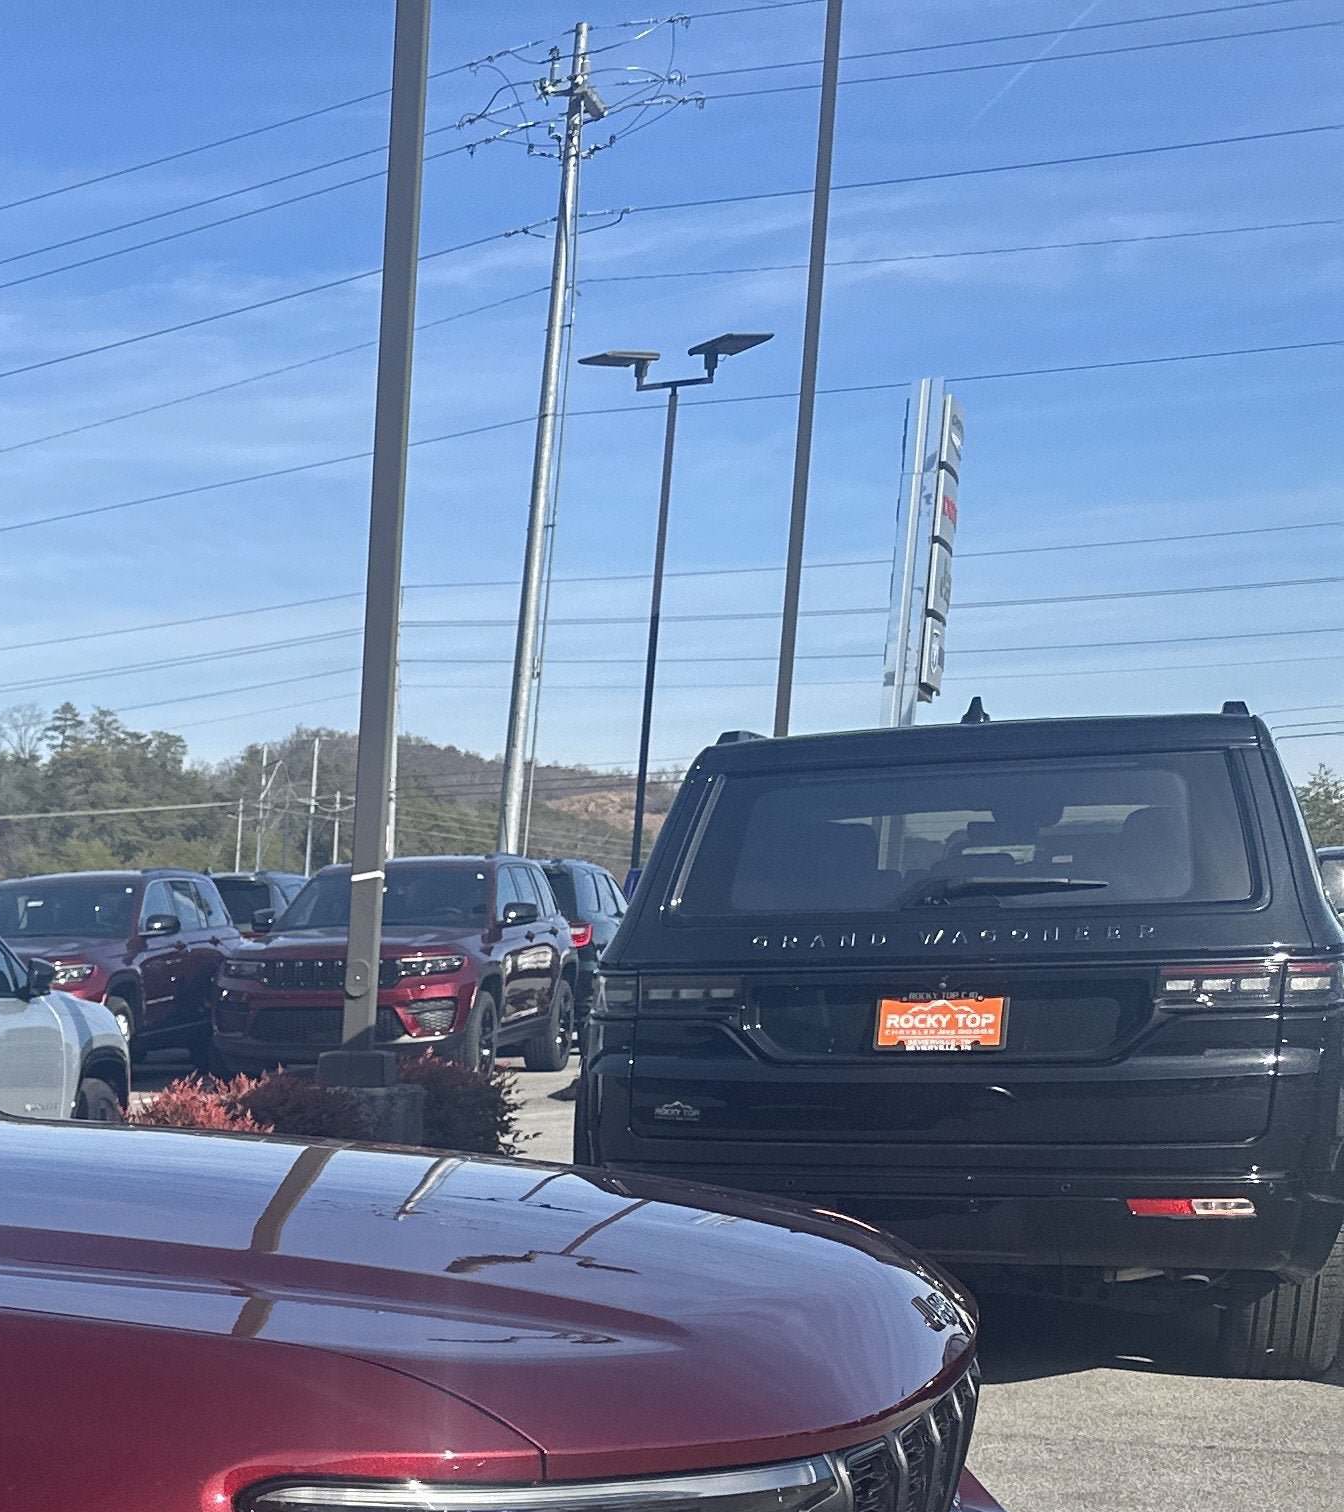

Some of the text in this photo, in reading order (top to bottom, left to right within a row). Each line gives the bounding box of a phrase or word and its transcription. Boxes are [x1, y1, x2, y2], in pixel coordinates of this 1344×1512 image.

[752, 925, 1155, 949] GRAND WAGONEER
[885, 1013, 995, 1028] ROCKY TOP
